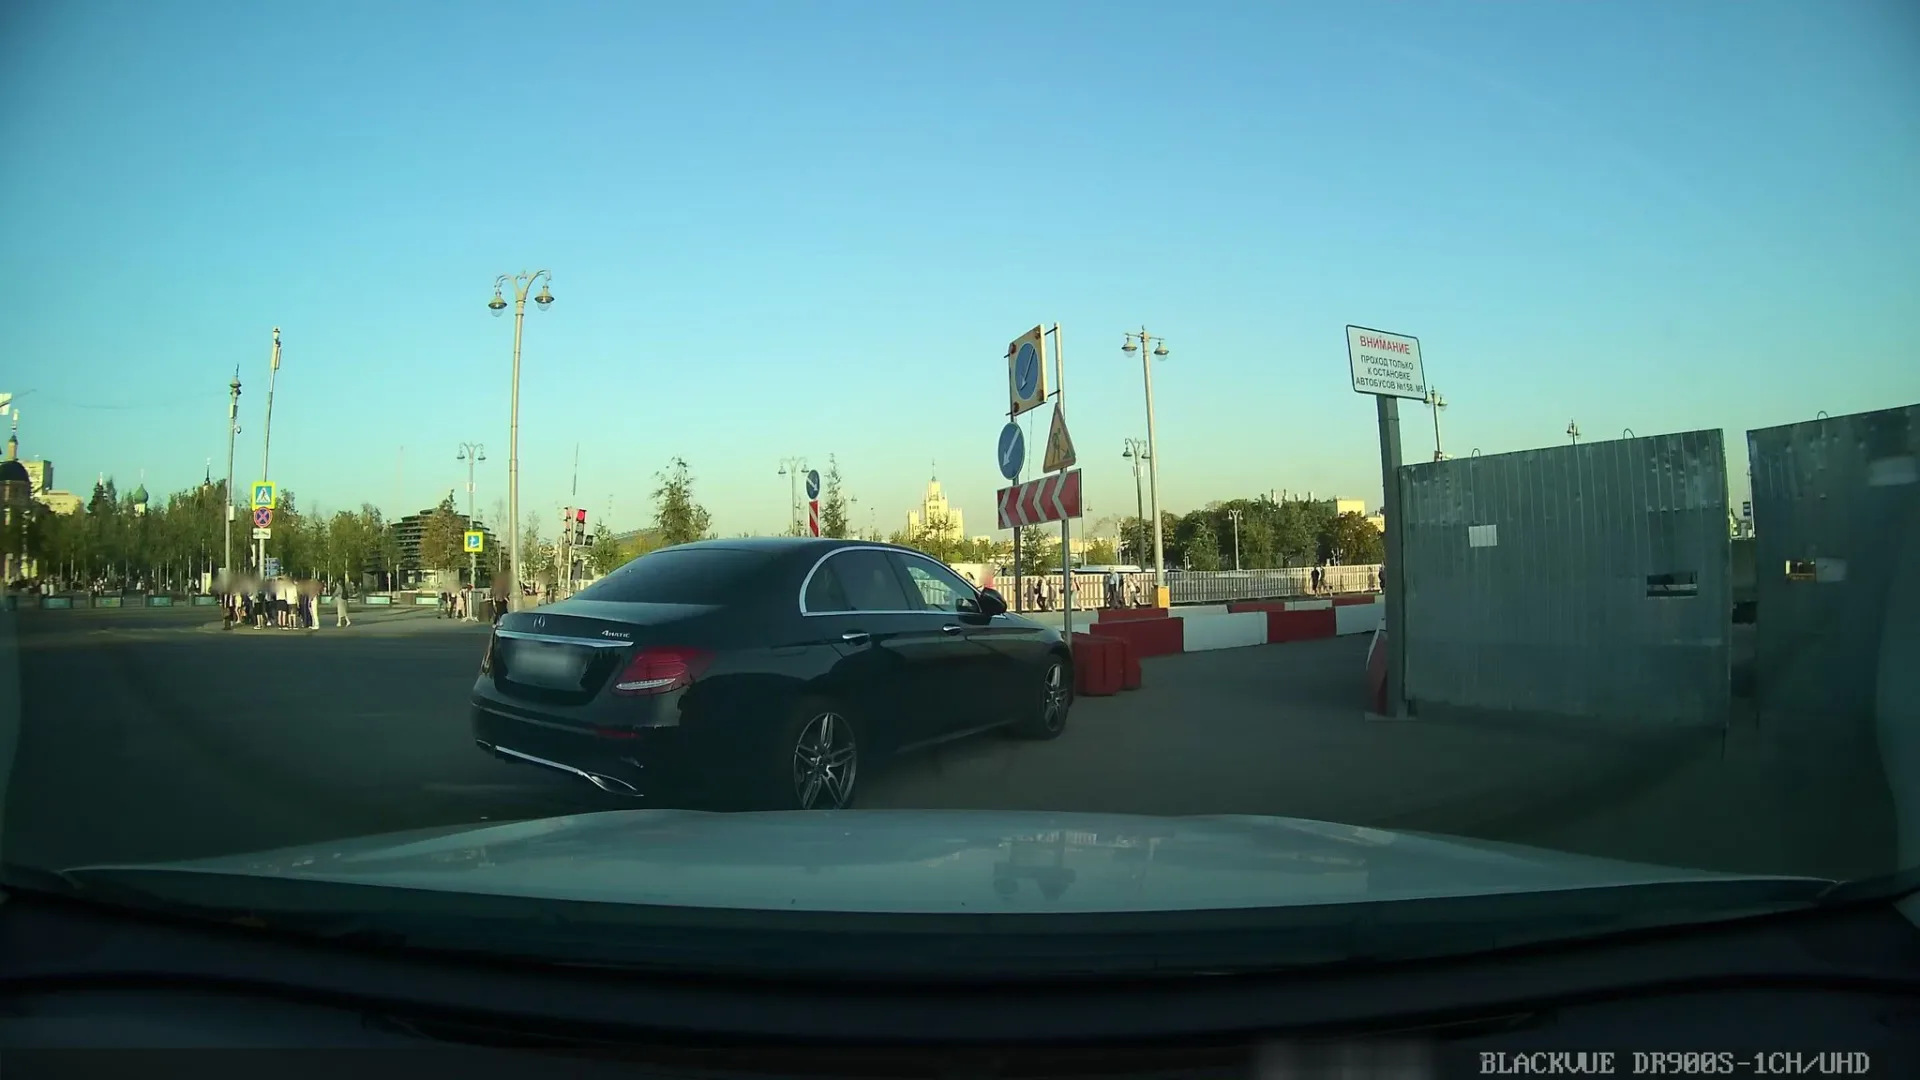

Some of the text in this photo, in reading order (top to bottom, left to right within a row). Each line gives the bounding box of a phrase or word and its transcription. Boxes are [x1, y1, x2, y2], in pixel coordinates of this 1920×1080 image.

[1360, 336, 1410, 355] ВНИМАНИЕ
[1361, 355, 1414, 370] ПРОХОД ТОЛЬКО
[1368, 367, 1411, 381] К ОСТАНОВКЕ
[1356, 377, 1396, 390] АВТОБУСОВ
[601, 630, 630, 638] 4MATIC
